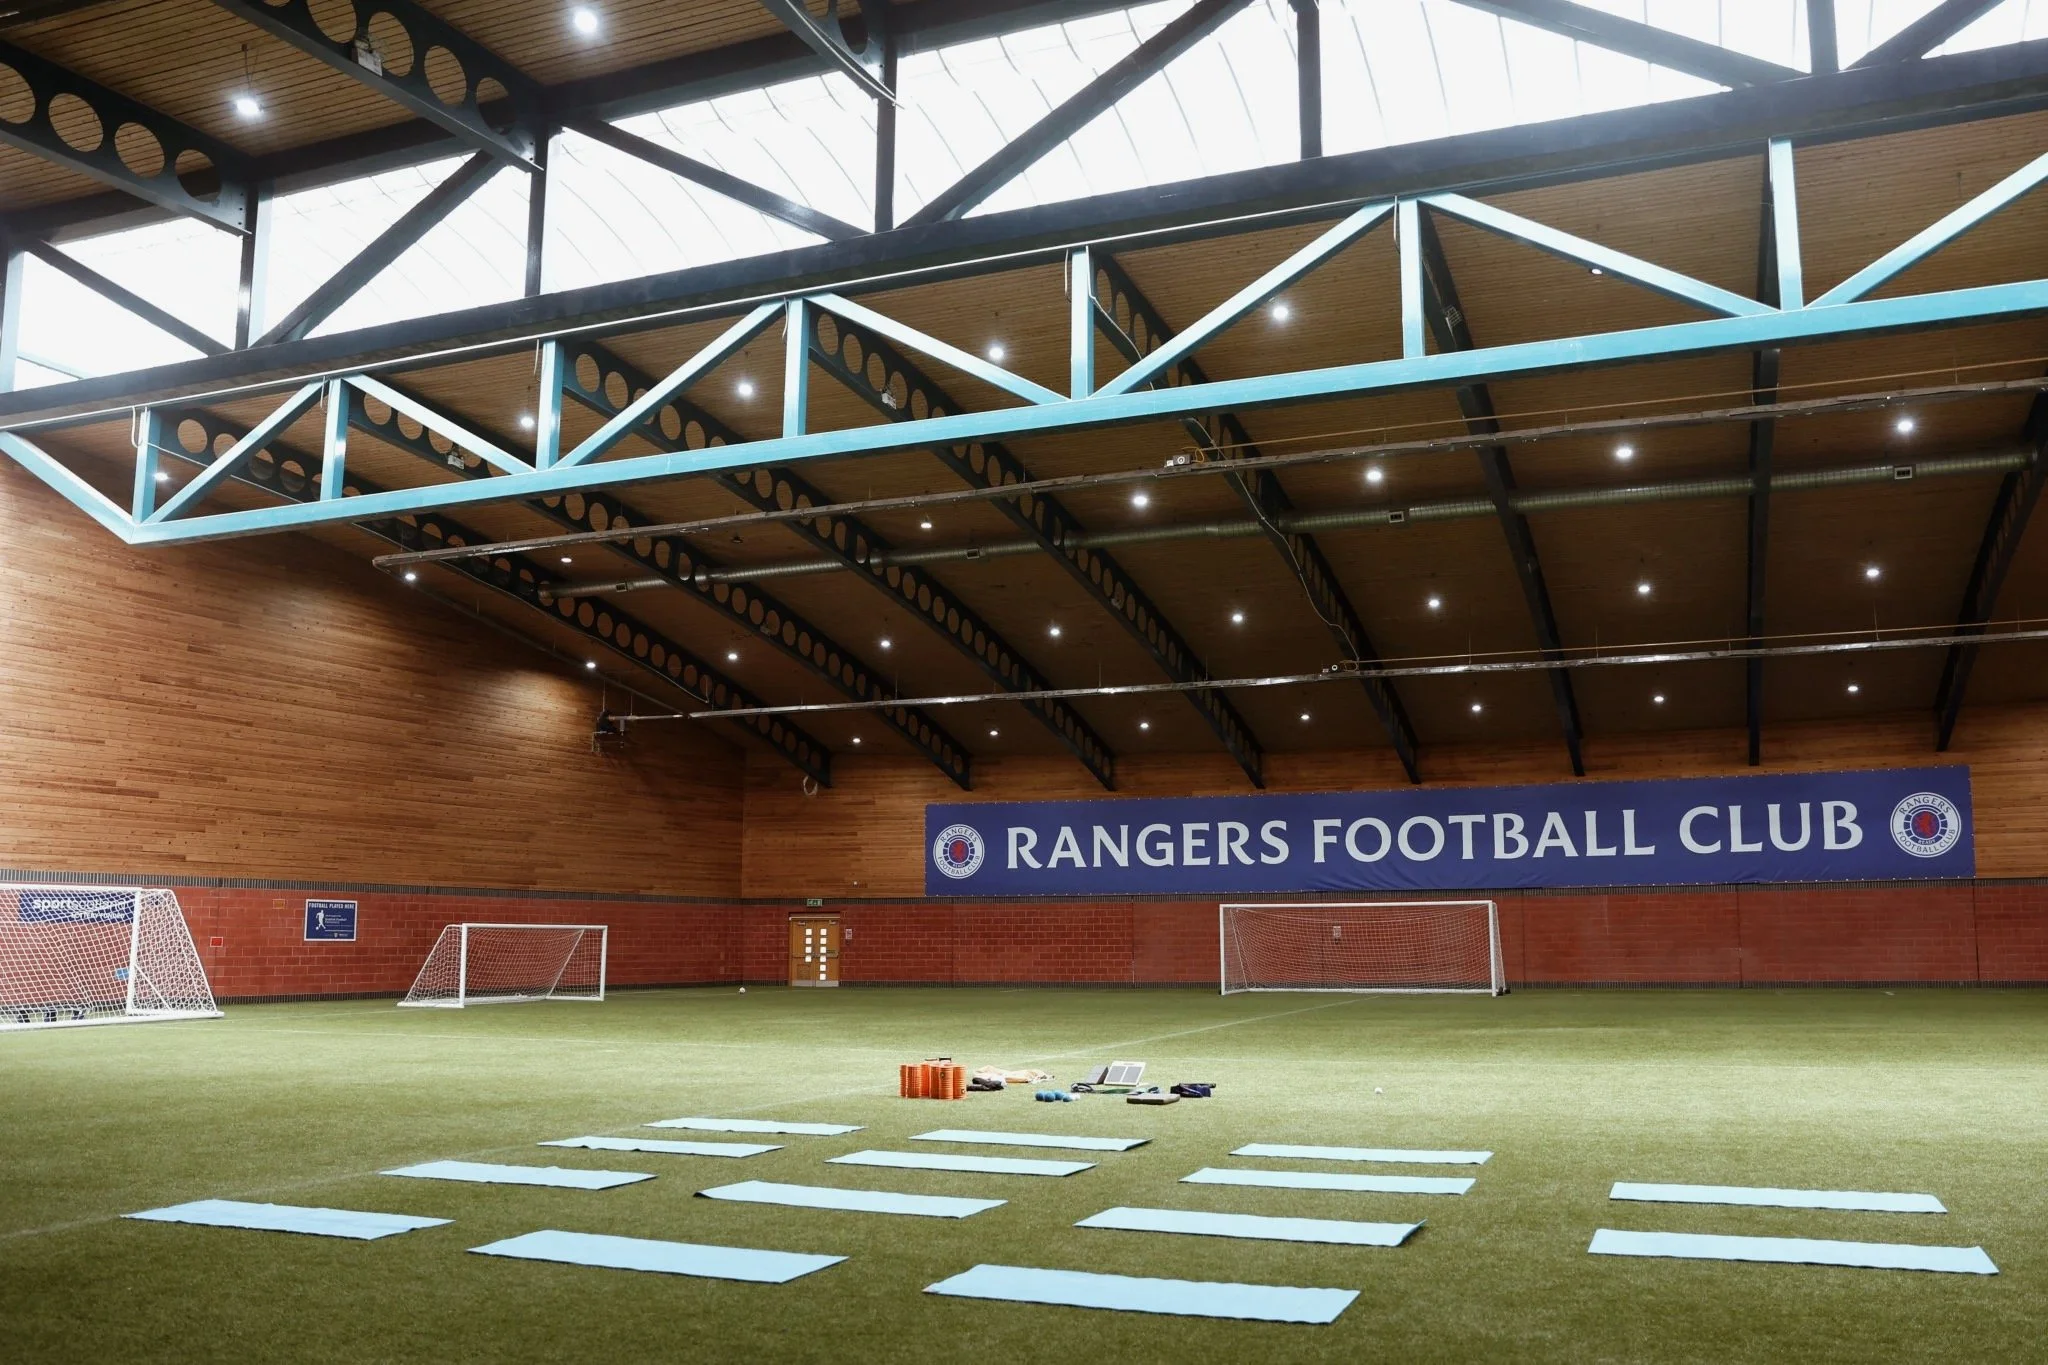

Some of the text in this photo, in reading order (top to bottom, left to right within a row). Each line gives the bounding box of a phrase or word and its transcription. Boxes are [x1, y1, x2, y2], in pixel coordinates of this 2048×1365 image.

[1899, 797, 1951, 814] RANGERS
[940, 827, 979, 843] RANGERS
[1008, 801, 1863, 869] RANGERS FOOTBALL CLUB
[1896, 829, 1956, 853] FOOTBALL CLUB
[938, 855, 981, 875] FOOTBALL CLUB
